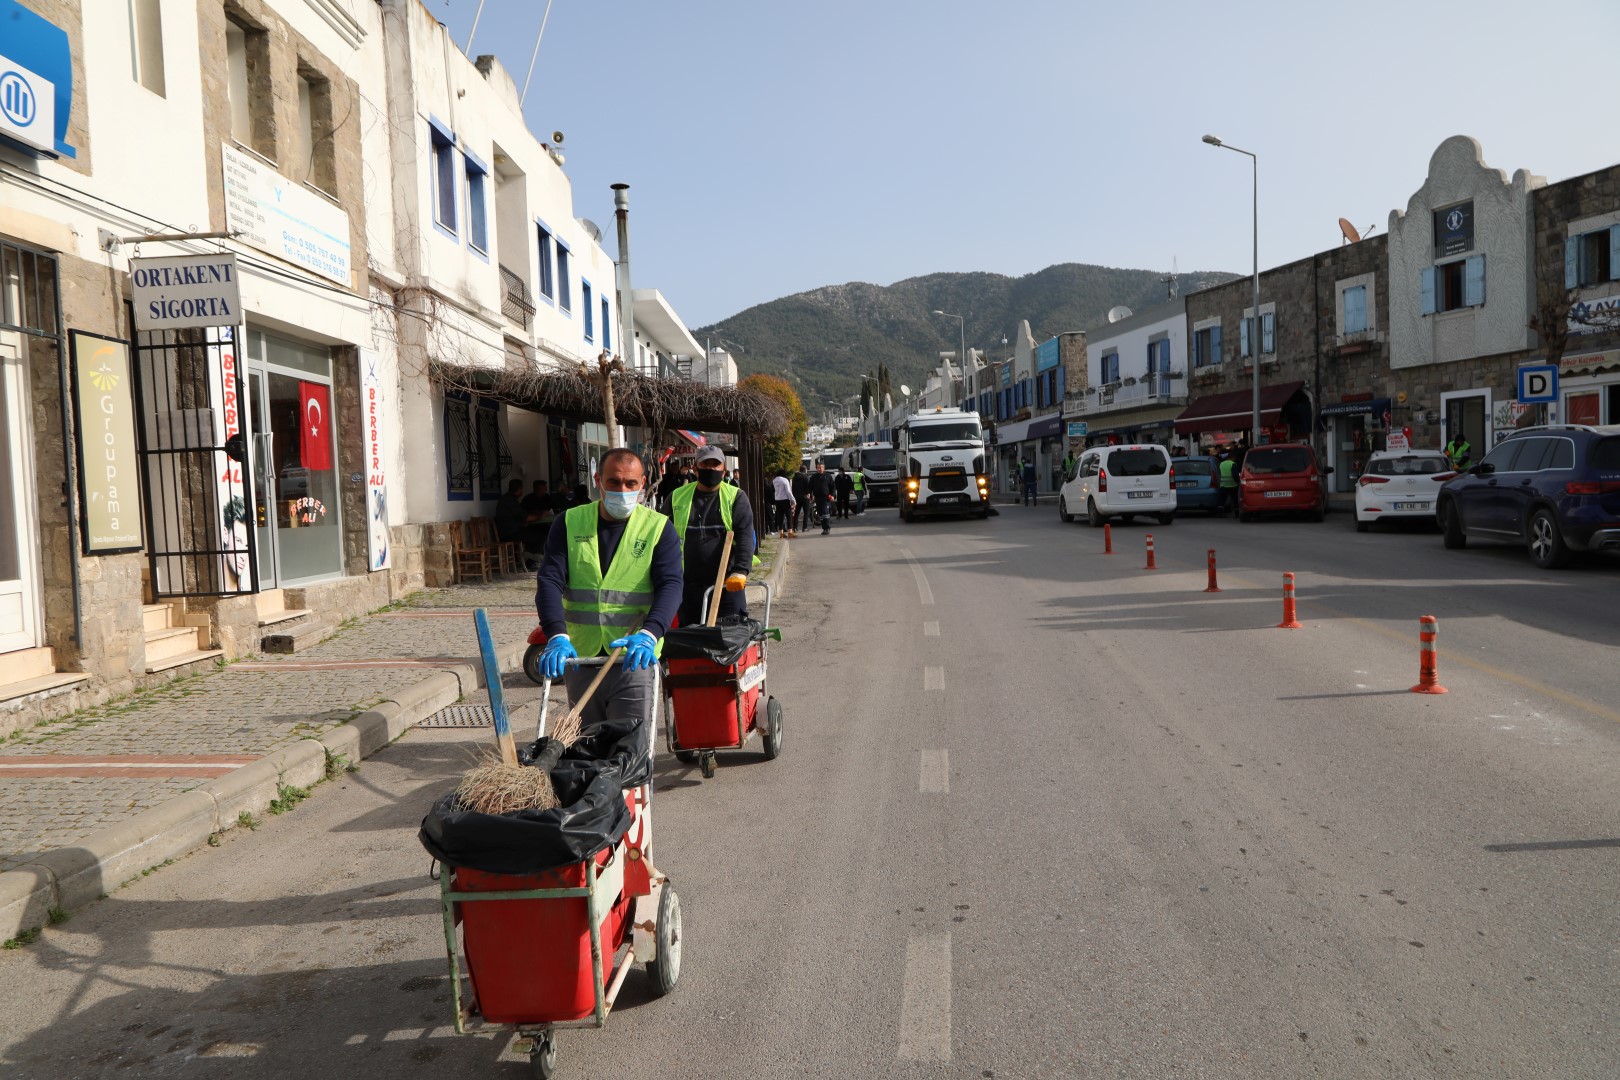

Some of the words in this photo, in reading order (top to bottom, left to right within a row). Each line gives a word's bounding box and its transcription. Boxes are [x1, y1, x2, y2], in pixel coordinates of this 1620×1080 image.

[134, 264, 232, 288] ORTAKENT
[150, 295, 230, 320] SİGORTA
[1529, 374, 1546, 394] D
[369, 388, 379, 470] BERBER
[100, 396, 120, 530] Groupama
[370, 472, 384, 486] ALİ
[290, 497, 327, 516] BERBER
[302, 510, 316, 522] ALİ
